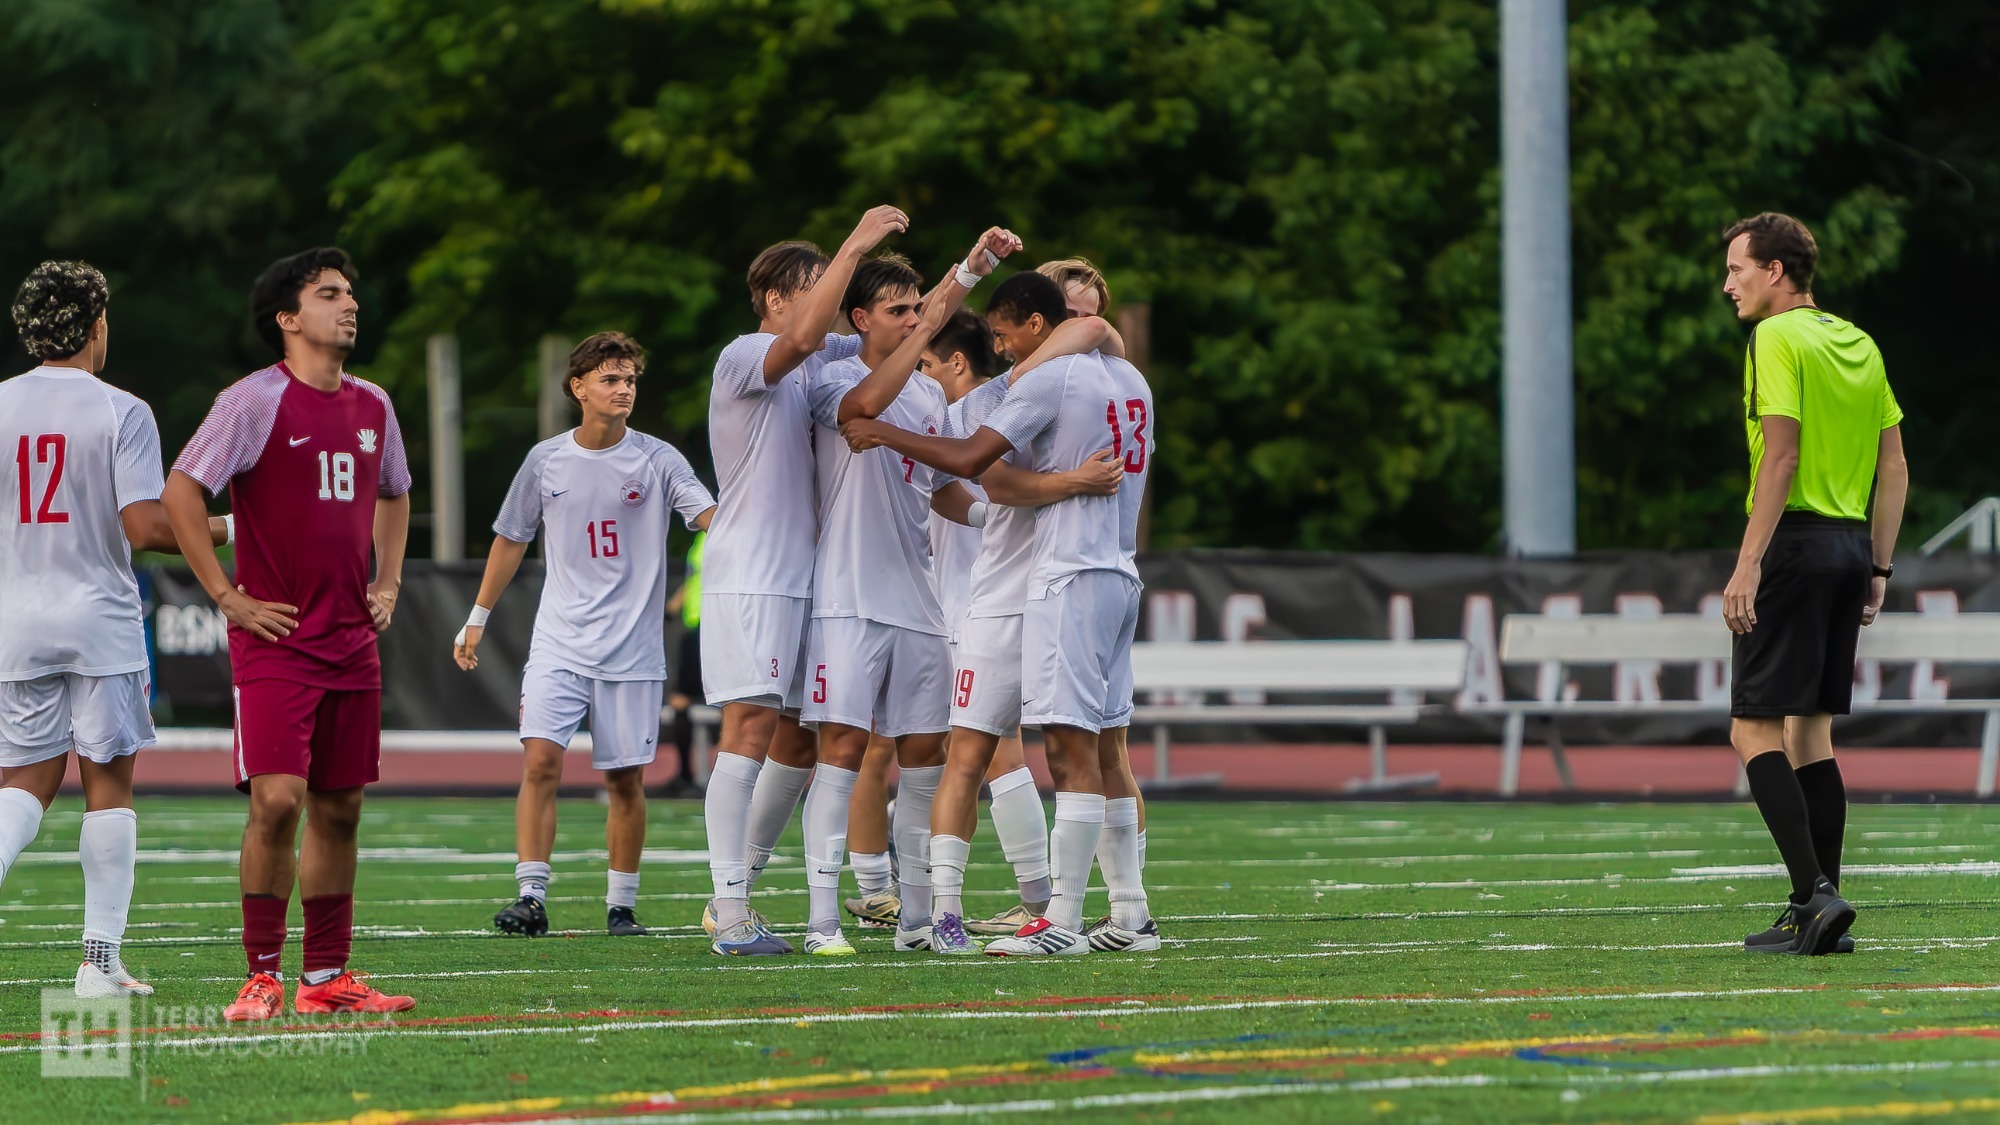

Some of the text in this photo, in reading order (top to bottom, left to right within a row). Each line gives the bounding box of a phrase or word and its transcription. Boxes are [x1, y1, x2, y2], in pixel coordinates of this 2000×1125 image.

[1106, 398, 1148, 475] 13
[16, 433, 70, 524] 12
[318, 450, 355, 502] 18
[586, 519, 620, 559] 15
[770, 657, 779, 679] 3
[812, 663, 828, 704] 5
